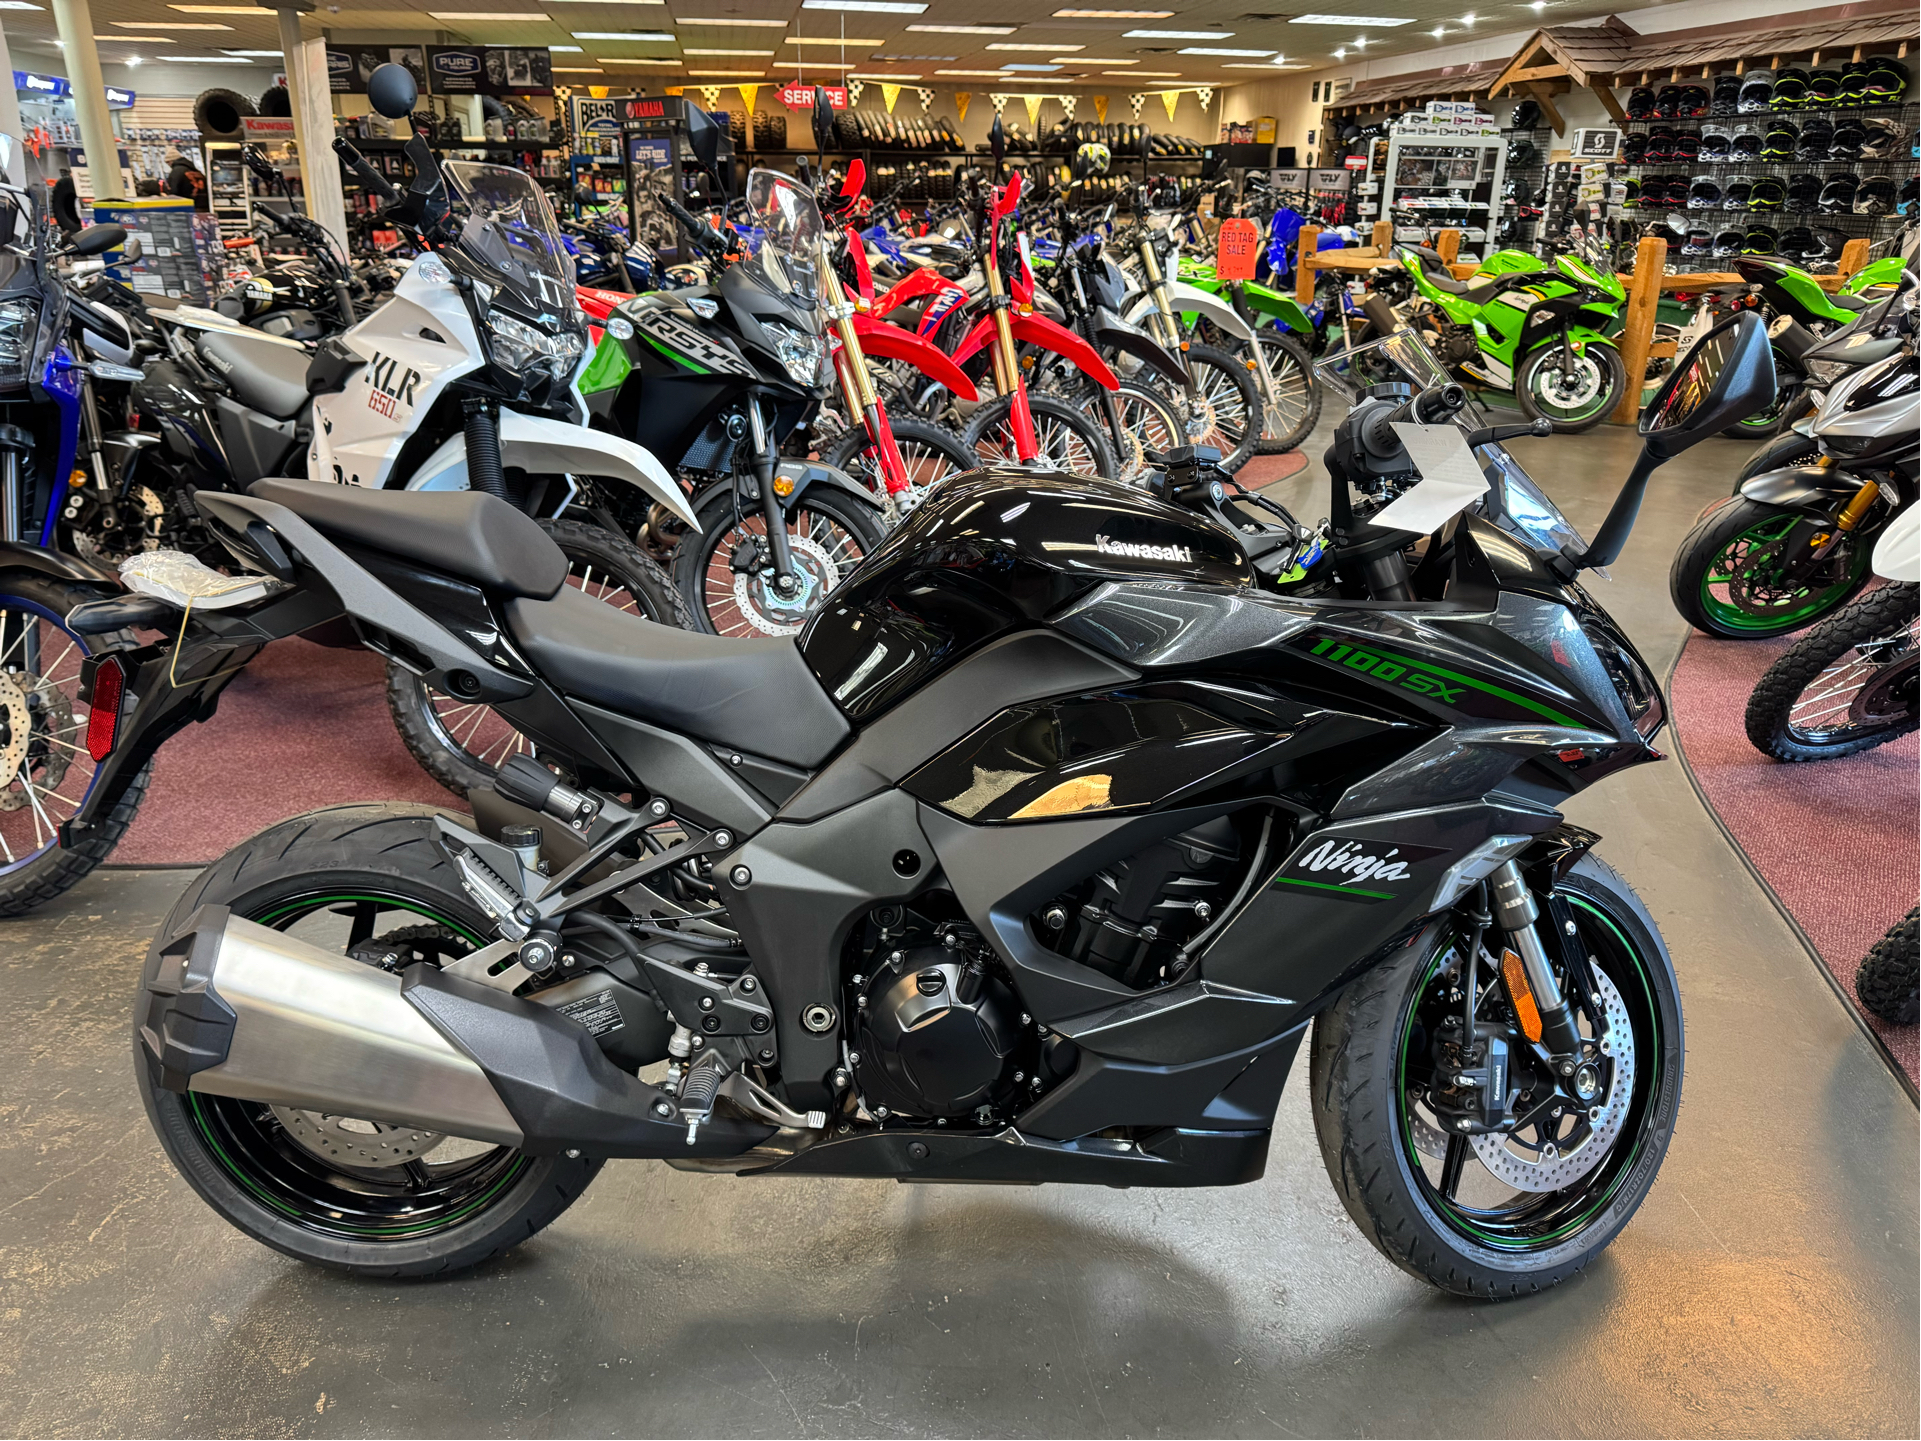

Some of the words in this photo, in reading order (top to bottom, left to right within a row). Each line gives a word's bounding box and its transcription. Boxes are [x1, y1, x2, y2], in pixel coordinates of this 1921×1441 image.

[439, 57, 474, 67] PURE
[783, 89, 844, 106] SERVCE
[633, 101, 665, 118] YAMAHA
[245, 119, 295, 131] Kawas
[1221, 231, 1237, 243] RED
[1239, 232, 1254, 243] TAG
[1226, 244, 1247, 256] SALE
[595, 290, 628, 305] HON
[364, 351, 421, 408] KLR
[368, 389, 397, 420] 650
[1095, 533, 1193, 563] Kawasaki
[1310, 638, 1407, 682] 1100
[1399, 673, 1467, 704] SX
[1298, 839, 1411, 886] Ninja
[1493, 1065, 1502, 1101] Kawasaki
[1659, 1063, 1676, 1123] BRIDGESTONE
